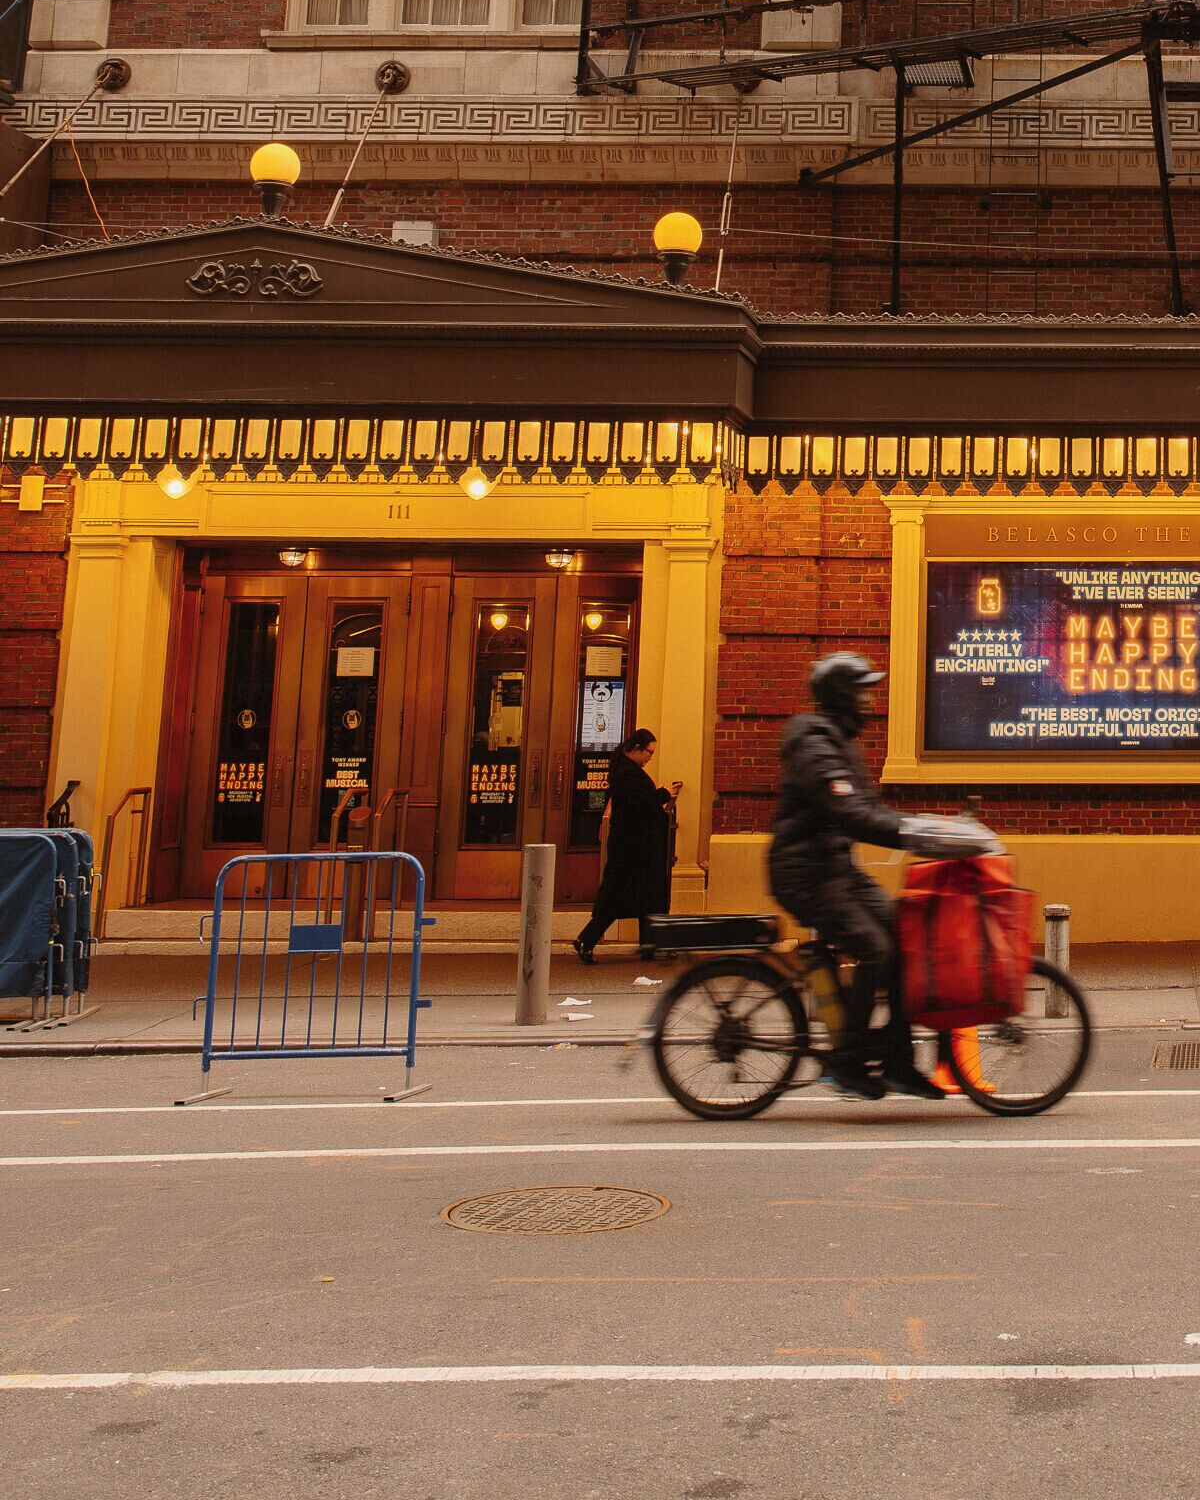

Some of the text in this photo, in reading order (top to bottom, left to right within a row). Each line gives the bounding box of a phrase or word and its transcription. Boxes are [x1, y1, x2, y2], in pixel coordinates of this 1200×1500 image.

[388, 504, 410, 520] 111
[987, 527, 1118, 543] BELASCO
[1055, 571, 1200, 585] “UNLIKE ANYTHING
[1072, 586, 1198, 599] I’VE EVER SEEN!”
[1069, 616, 1197, 638] MAYBE
[949, 643, 1022, 657] “UTTERLY
[1069, 643, 1197, 664] HAPPY
[935, 659, 1050, 673] ENCHANTING!”
[1069, 668, 1197, 690] ENDING
[1021, 708, 1057, 721] “THE
[1060, 708, 1102, 724] BEST,
[1105, 708, 1151, 721] MOST
[990, 723, 1036, 737] MOST
[1040, 723, 1123, 737] BEAUTIFUL
[1126, 723, 1198, 737] MUSICAL
[221, 763, 265, 772] MAYBE
[472, 764, 516, 773] MAYBE
[220, 772, 264, 780] HAPPY
[336, 771, 360, 779] BEST
[587, 772, 609, 780] BEST
[219, 781, 263, 789] ENDING
[325, 779, 368, 787] MUSICAL
[471, 782, 515, 790] ENDING
[577, 780, 609, 790] MUSIC
